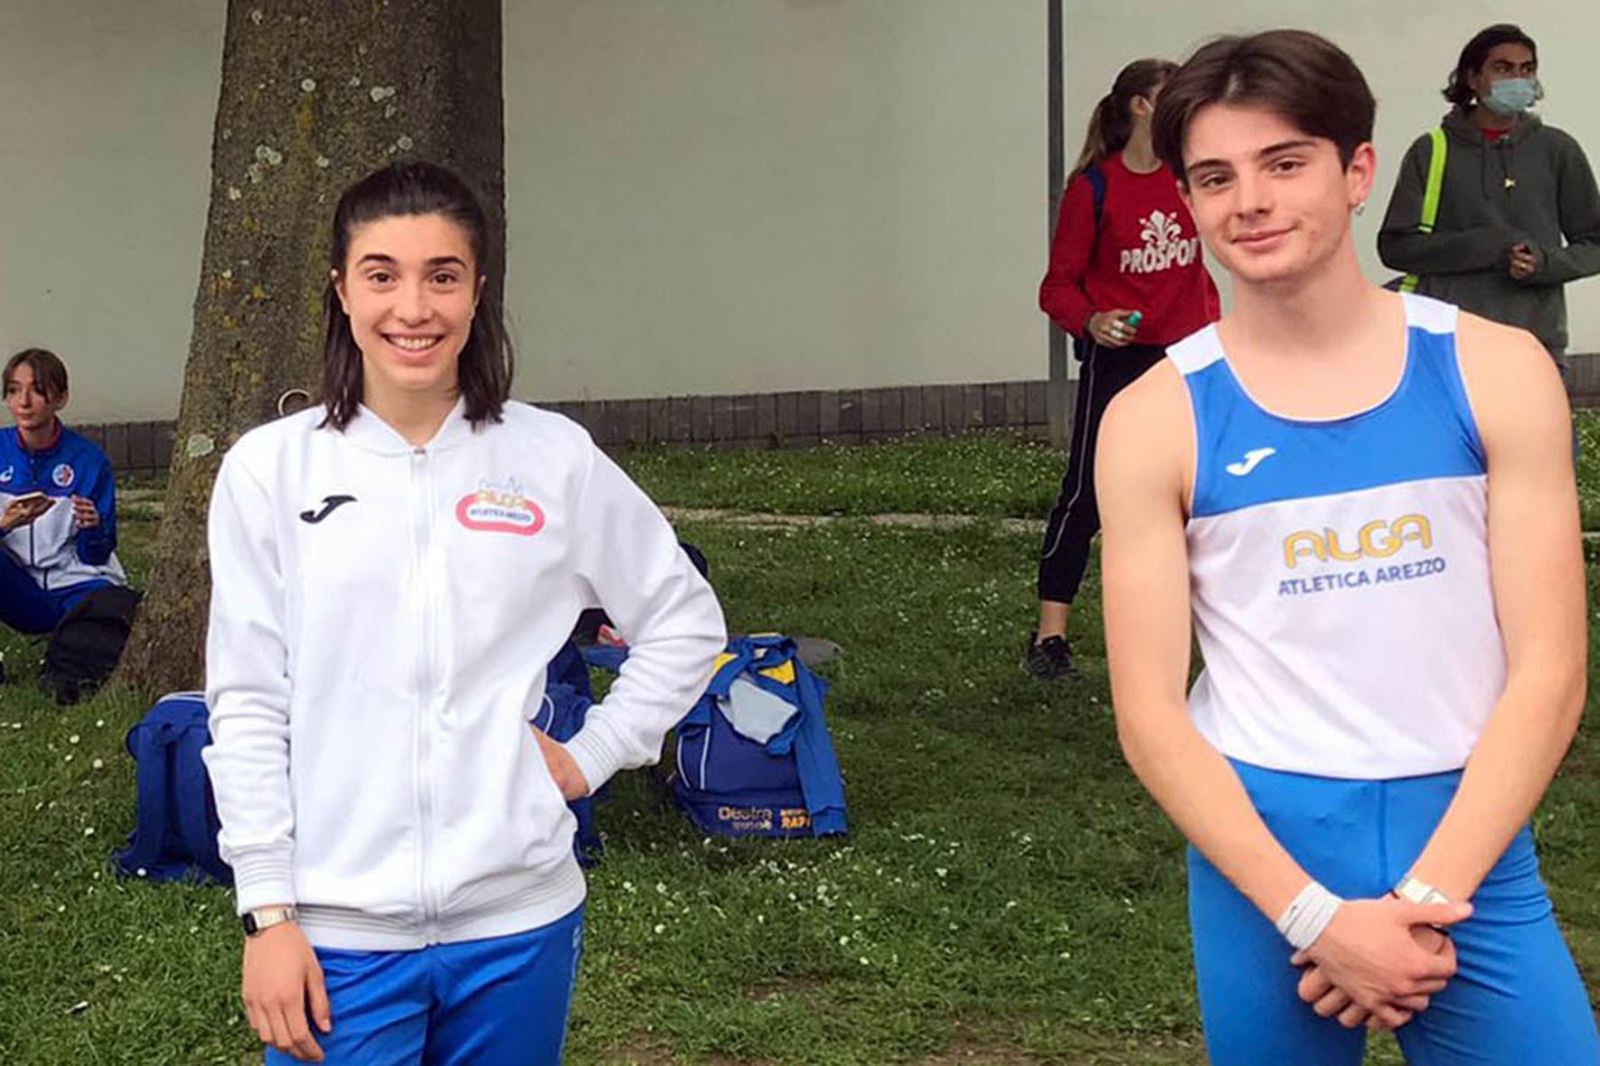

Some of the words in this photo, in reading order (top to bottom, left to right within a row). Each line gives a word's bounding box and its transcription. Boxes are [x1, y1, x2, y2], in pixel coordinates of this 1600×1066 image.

[1284, 514, 1433, 569] ALGA
[1278, 573, 1371, 596] ATLETICA
[1375, 557, 1446, 584] AREZZO
